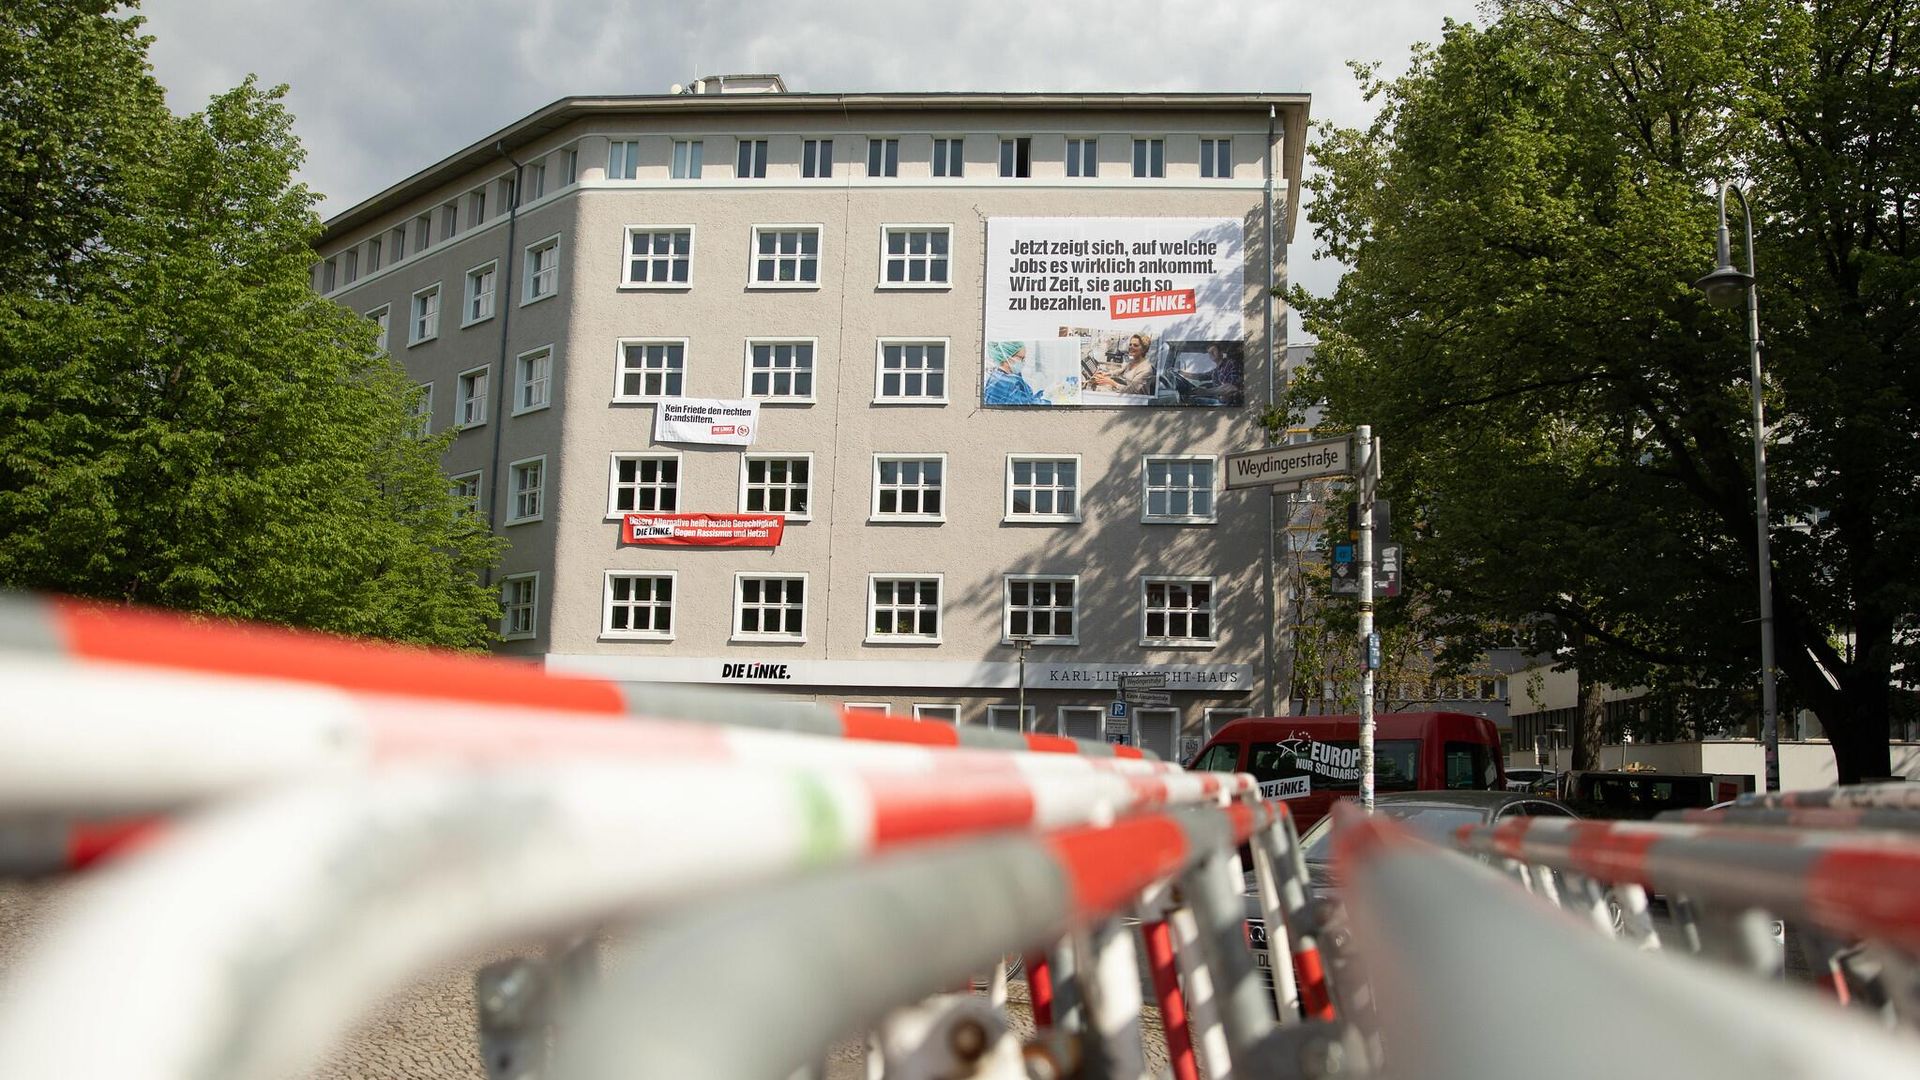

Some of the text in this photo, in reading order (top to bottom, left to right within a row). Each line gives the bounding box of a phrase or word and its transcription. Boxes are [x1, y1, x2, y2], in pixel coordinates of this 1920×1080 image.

[1010, 239, 1217, 257] Jetzt zeigt sich, auf welche
[1009, 258, 1217, 273] Jobs es wirklich ankommt.
[1009, 276, 1173, 293] Wird Zeit, sie auch so
[1009, 295, 1106, 311] zu bezahlen.
[1115, 298, 1141, 315] DIE
[665, 404, 751, 416] Kein Friede den rechten
[664, 413, 715, 424] Brandstiftern.
[1238, 448, 1337, 477] Weydingerstraße
[653, 518, 690, 527] Alternative
[690, 519, 707, 528] heißt
[707, 520, 732, 528] soziale
[732, 519, 779, 529] Gerechtigkeit.
[636, 527, 648, 536] DIE
[675, 528, 769, 538] Gegen Rassismus und Hetze!
[722, 663, 745, 678] DIE
[1310, 741, 1361, 768] EUROP
[1295, 758, 1360, 780] NUR SOLIDARIS
